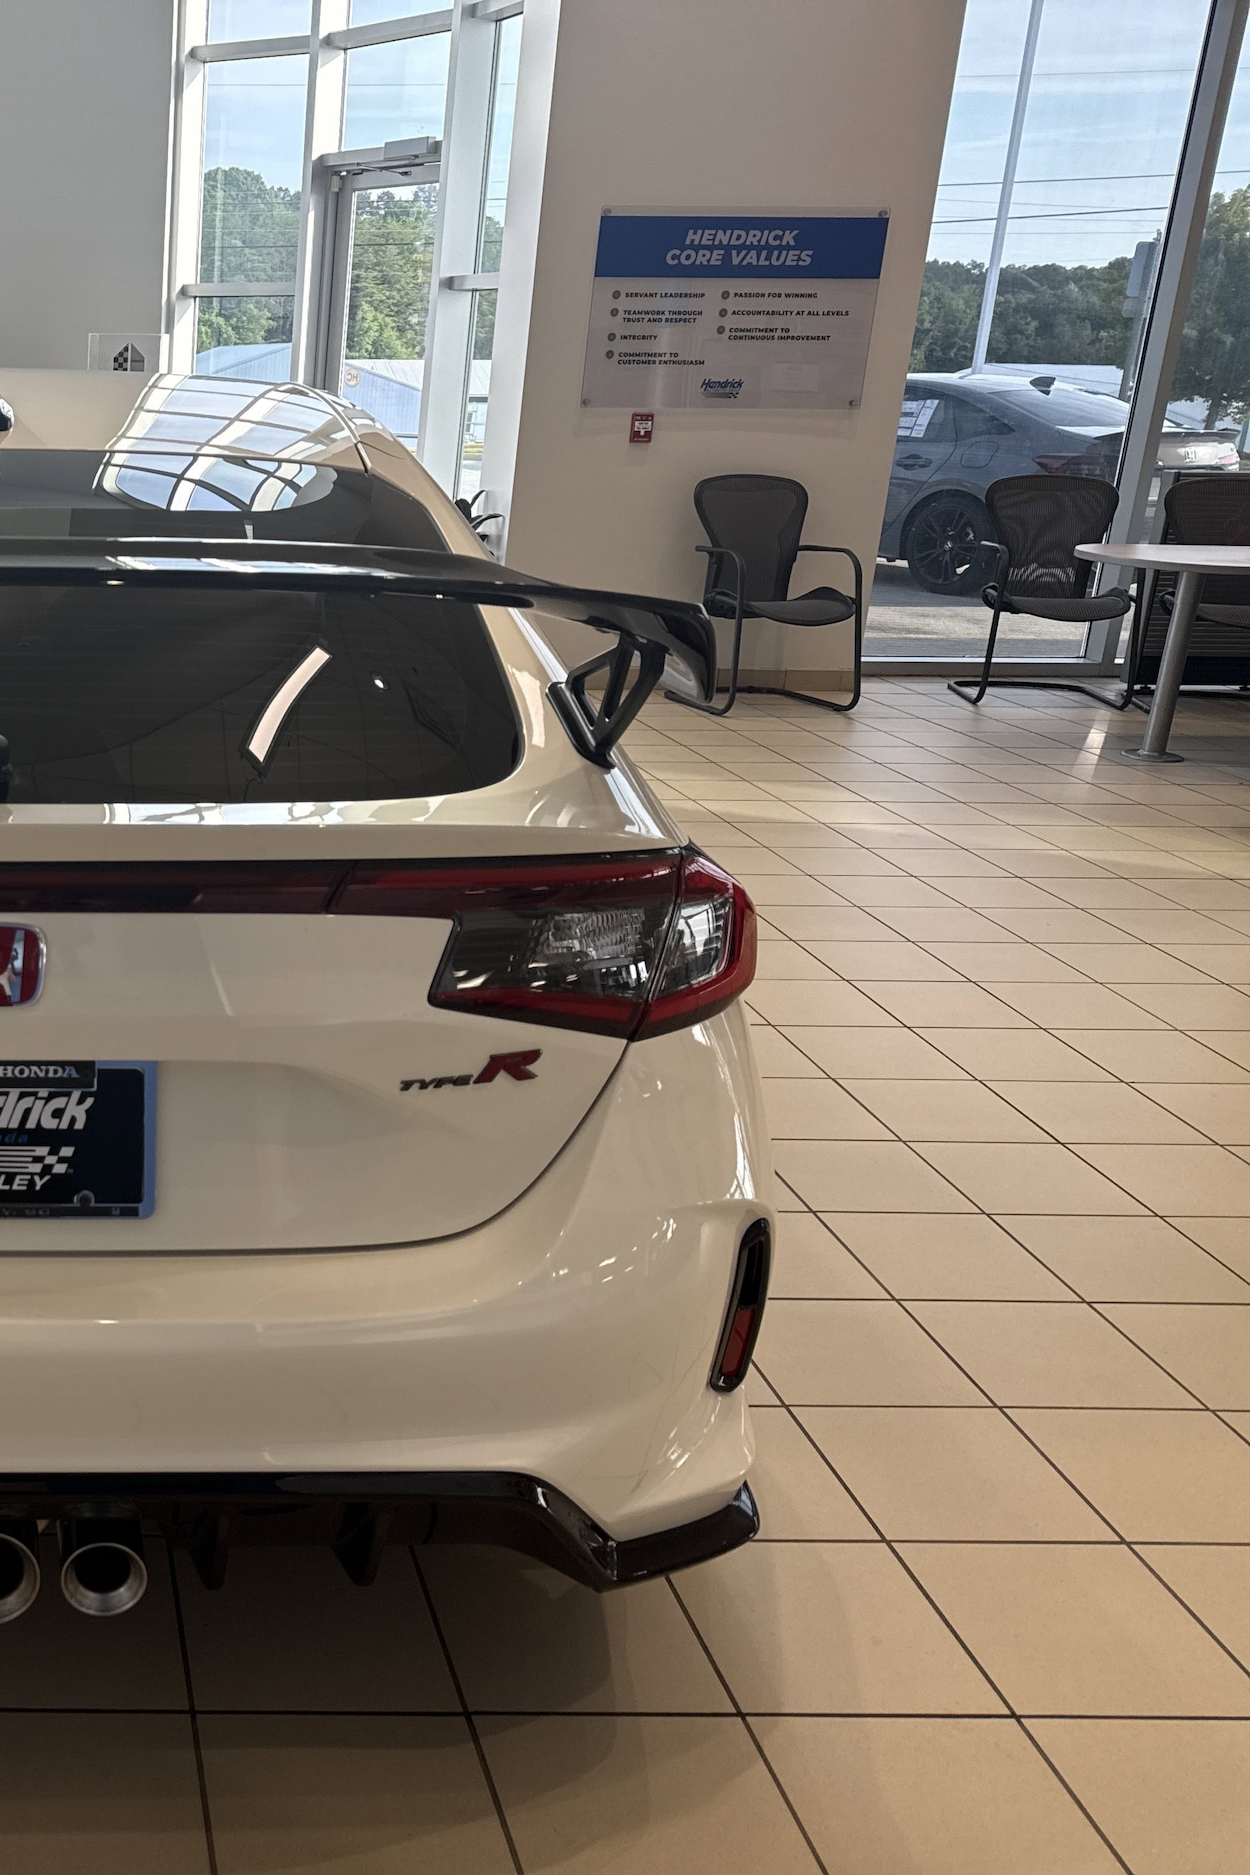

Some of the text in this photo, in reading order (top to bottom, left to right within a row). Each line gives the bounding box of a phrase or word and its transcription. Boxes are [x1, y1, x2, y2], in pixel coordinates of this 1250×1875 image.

[684, 229, 799, 246] HENDRICK
[665, 249, 813, 267] CORE VALUES
[700, 378, 744, 391] Hendrick
[400, 1048, 543, 1092] TYPE R
